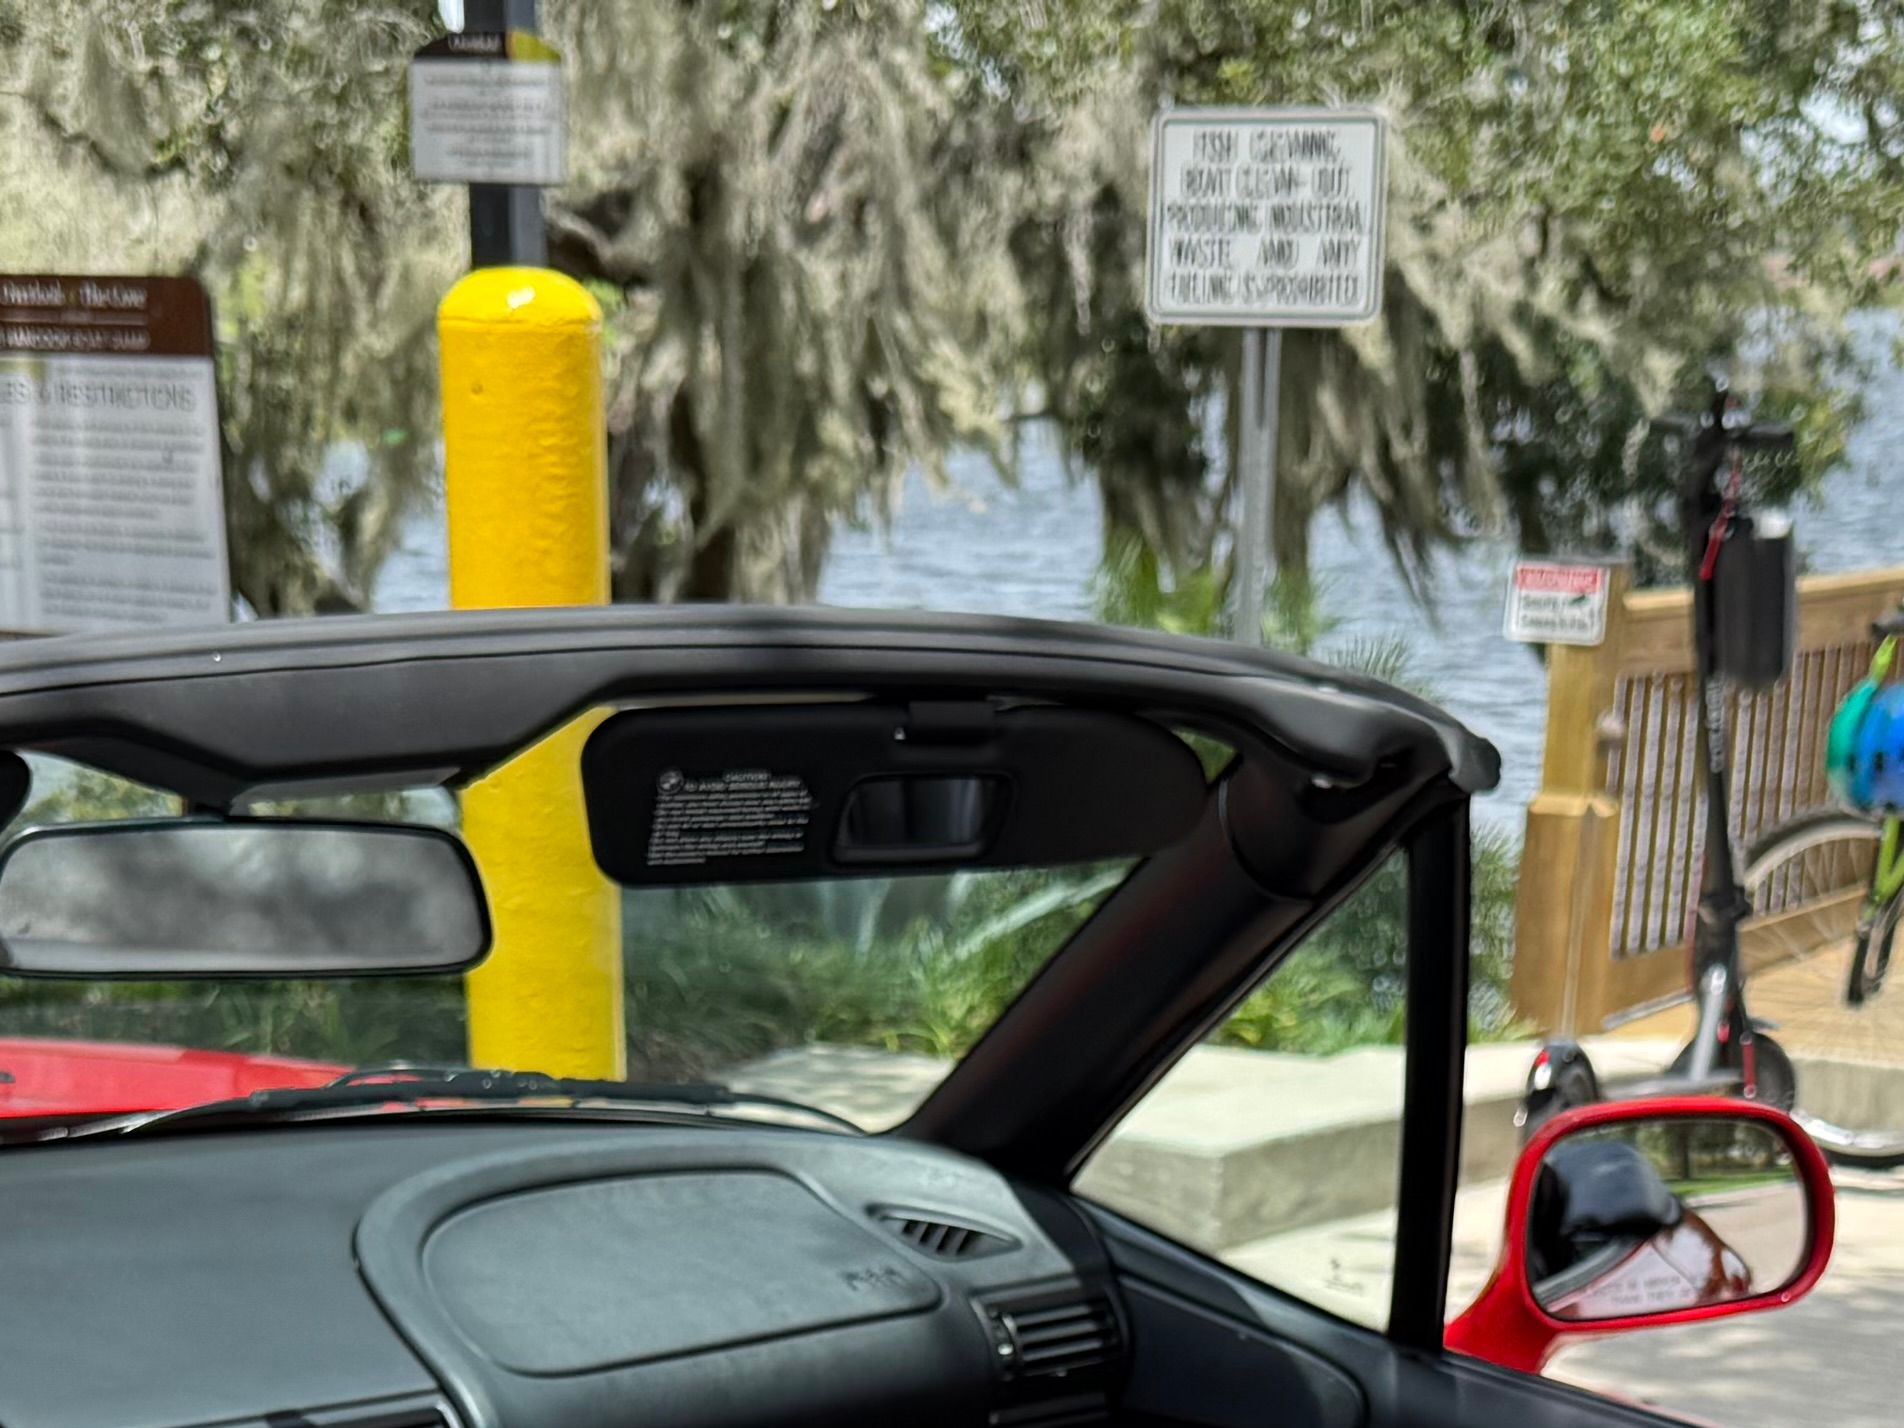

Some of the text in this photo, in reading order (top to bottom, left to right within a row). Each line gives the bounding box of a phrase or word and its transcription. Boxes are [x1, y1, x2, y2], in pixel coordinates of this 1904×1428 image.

[1192, 130, 1239, 161] FISH
[1180, 163, 1232, 196] BOAT
[1167, 198, 1363, 234] PRODUCING INDUSTRIAL
[1170, 238, 1361, 270] WASTE AND ANY
[1169, 271, 1234, 304] FUELING
[57, 381, 197, 412] RESTRICTIONS
